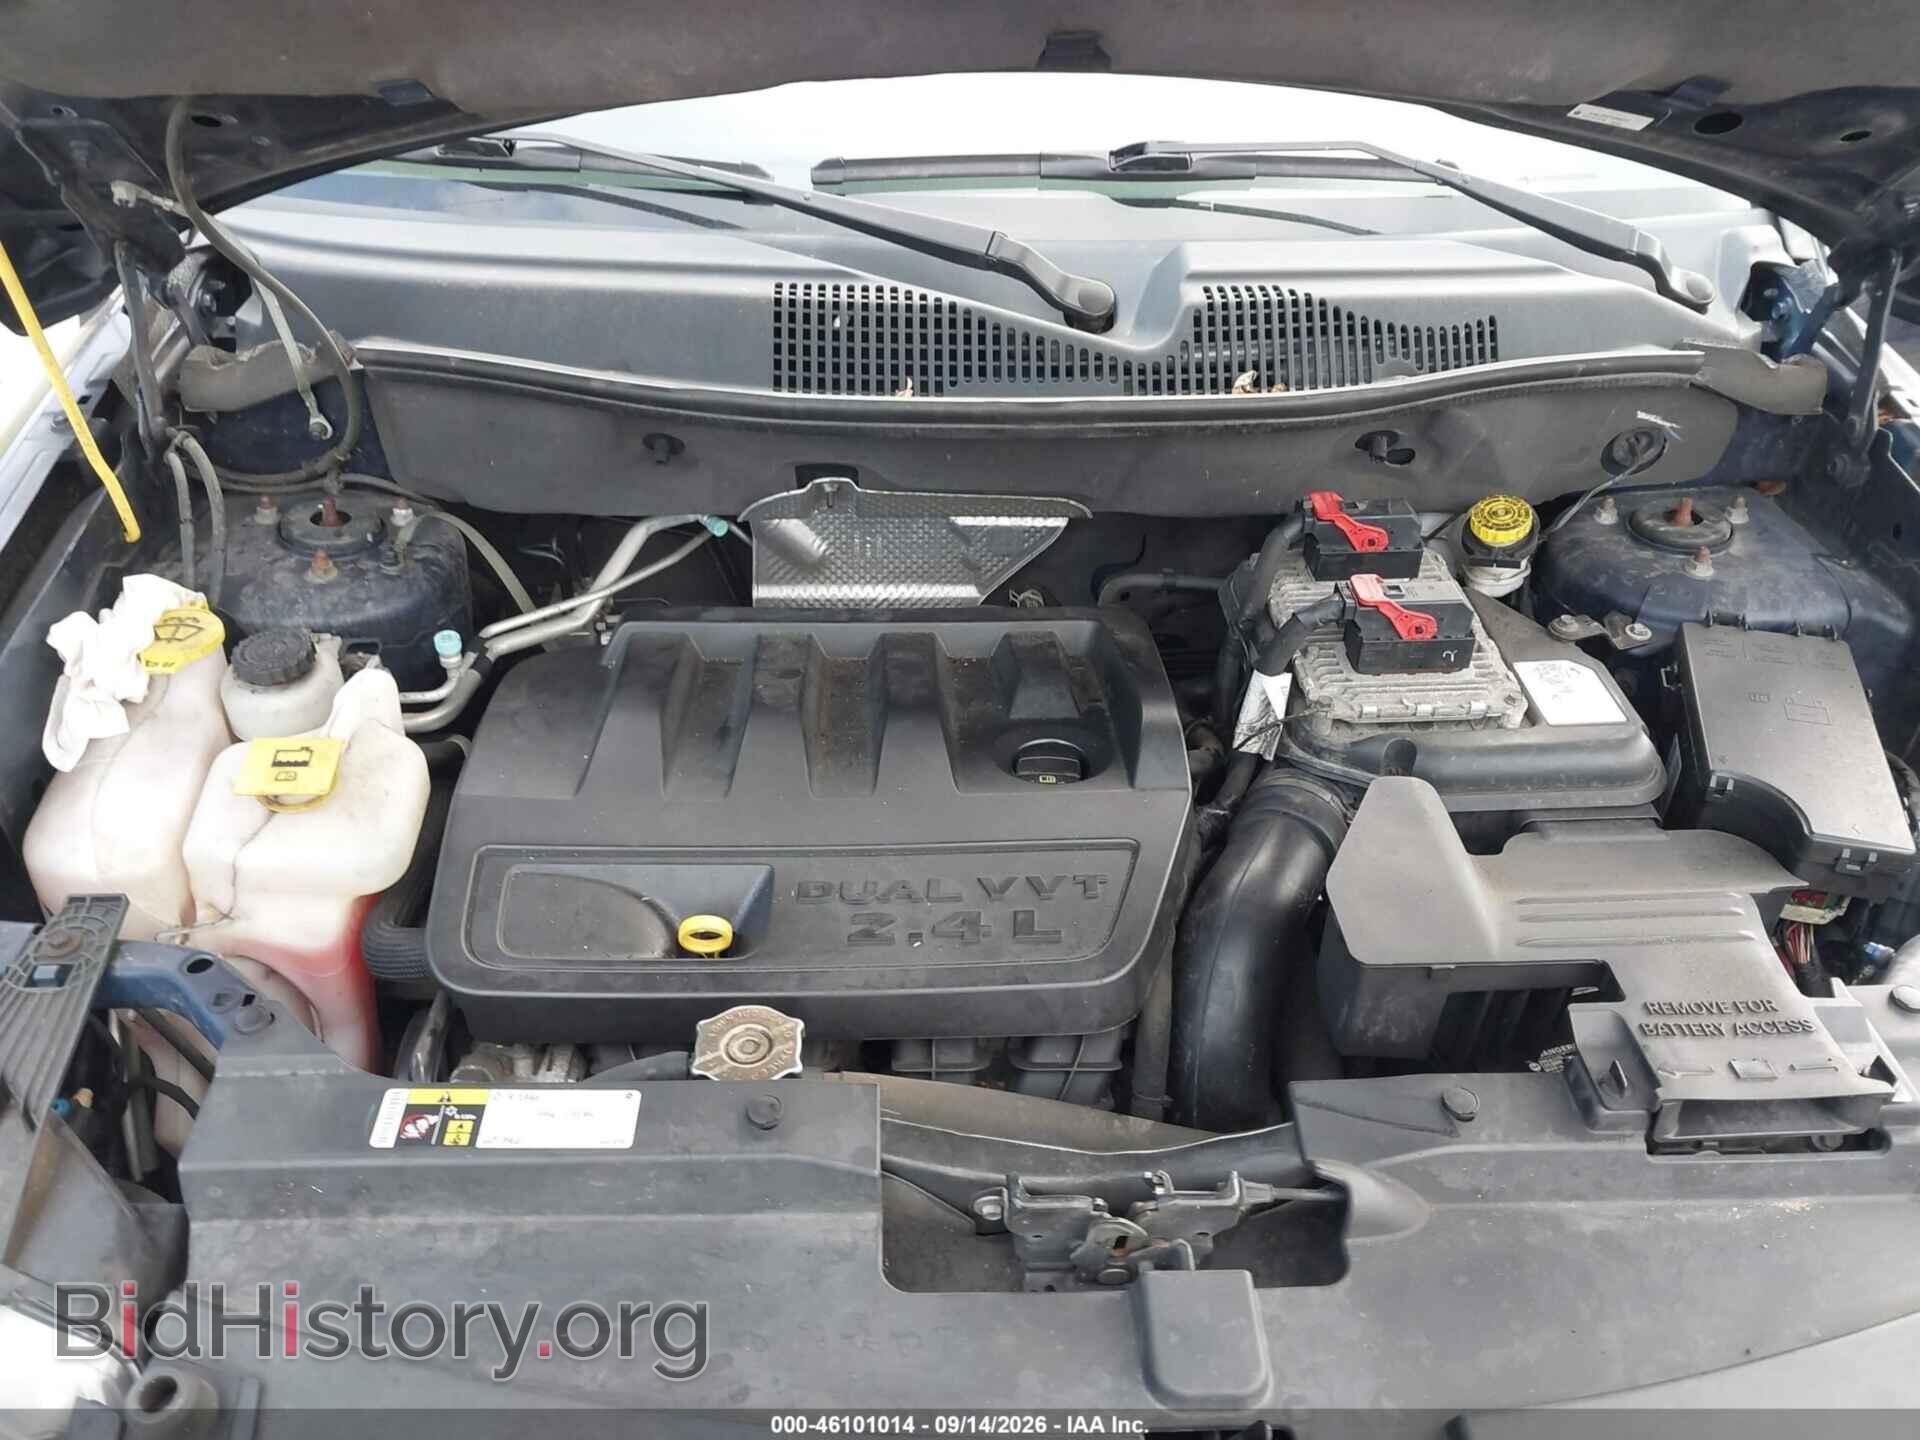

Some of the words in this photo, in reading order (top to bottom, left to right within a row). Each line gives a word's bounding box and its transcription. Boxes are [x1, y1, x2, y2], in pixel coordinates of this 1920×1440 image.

[796, 877, 963, 905] DUAL
[976, 873, 1108, 900] VVT
[1644, 1000, 1732, 1015] REMOVE
[1734, 1000, 1778, 1013] FOR
[1640, 1023, 1725, 1037] BATTERY
[1734, 1018, 1816, 1036] ACCESS
